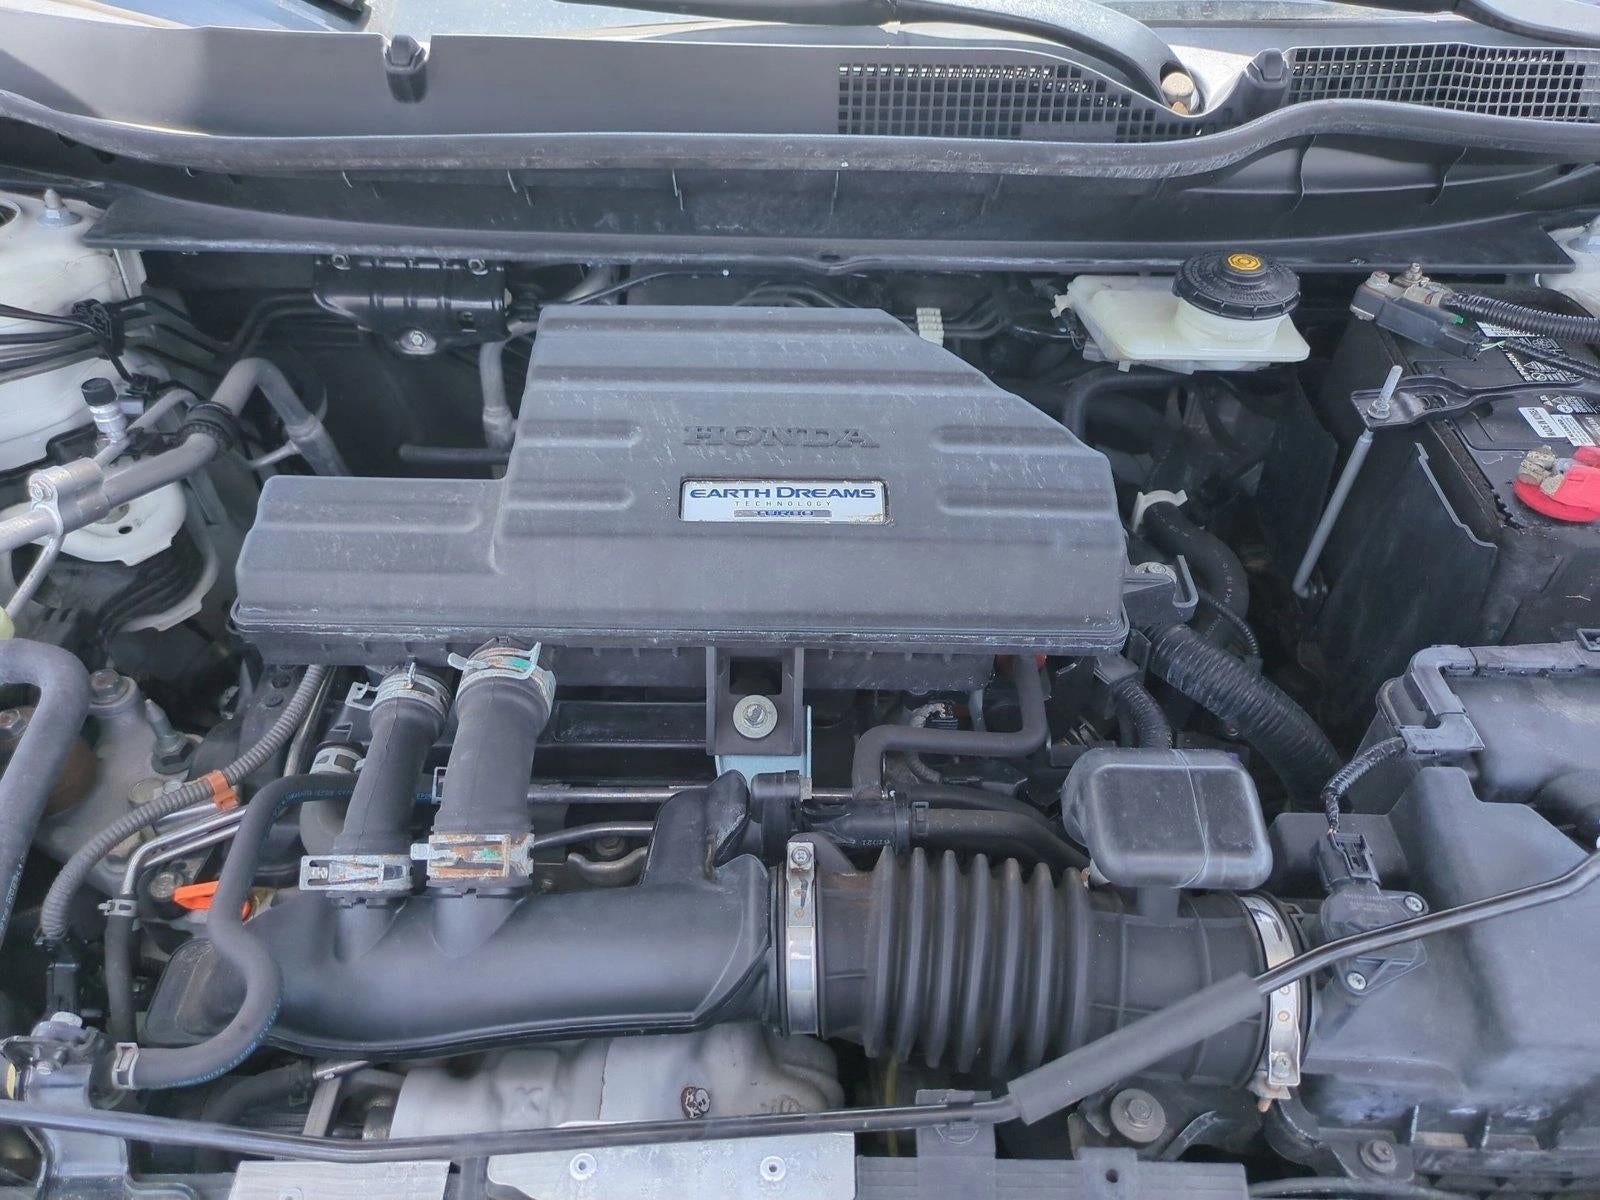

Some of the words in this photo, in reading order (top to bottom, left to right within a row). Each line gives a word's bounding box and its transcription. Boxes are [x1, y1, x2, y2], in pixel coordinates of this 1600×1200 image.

[684, 426, 880, 448] HONDA
[690, 487, 772, 499] EARTH
[776, 487, 876, 499] DREAMS
